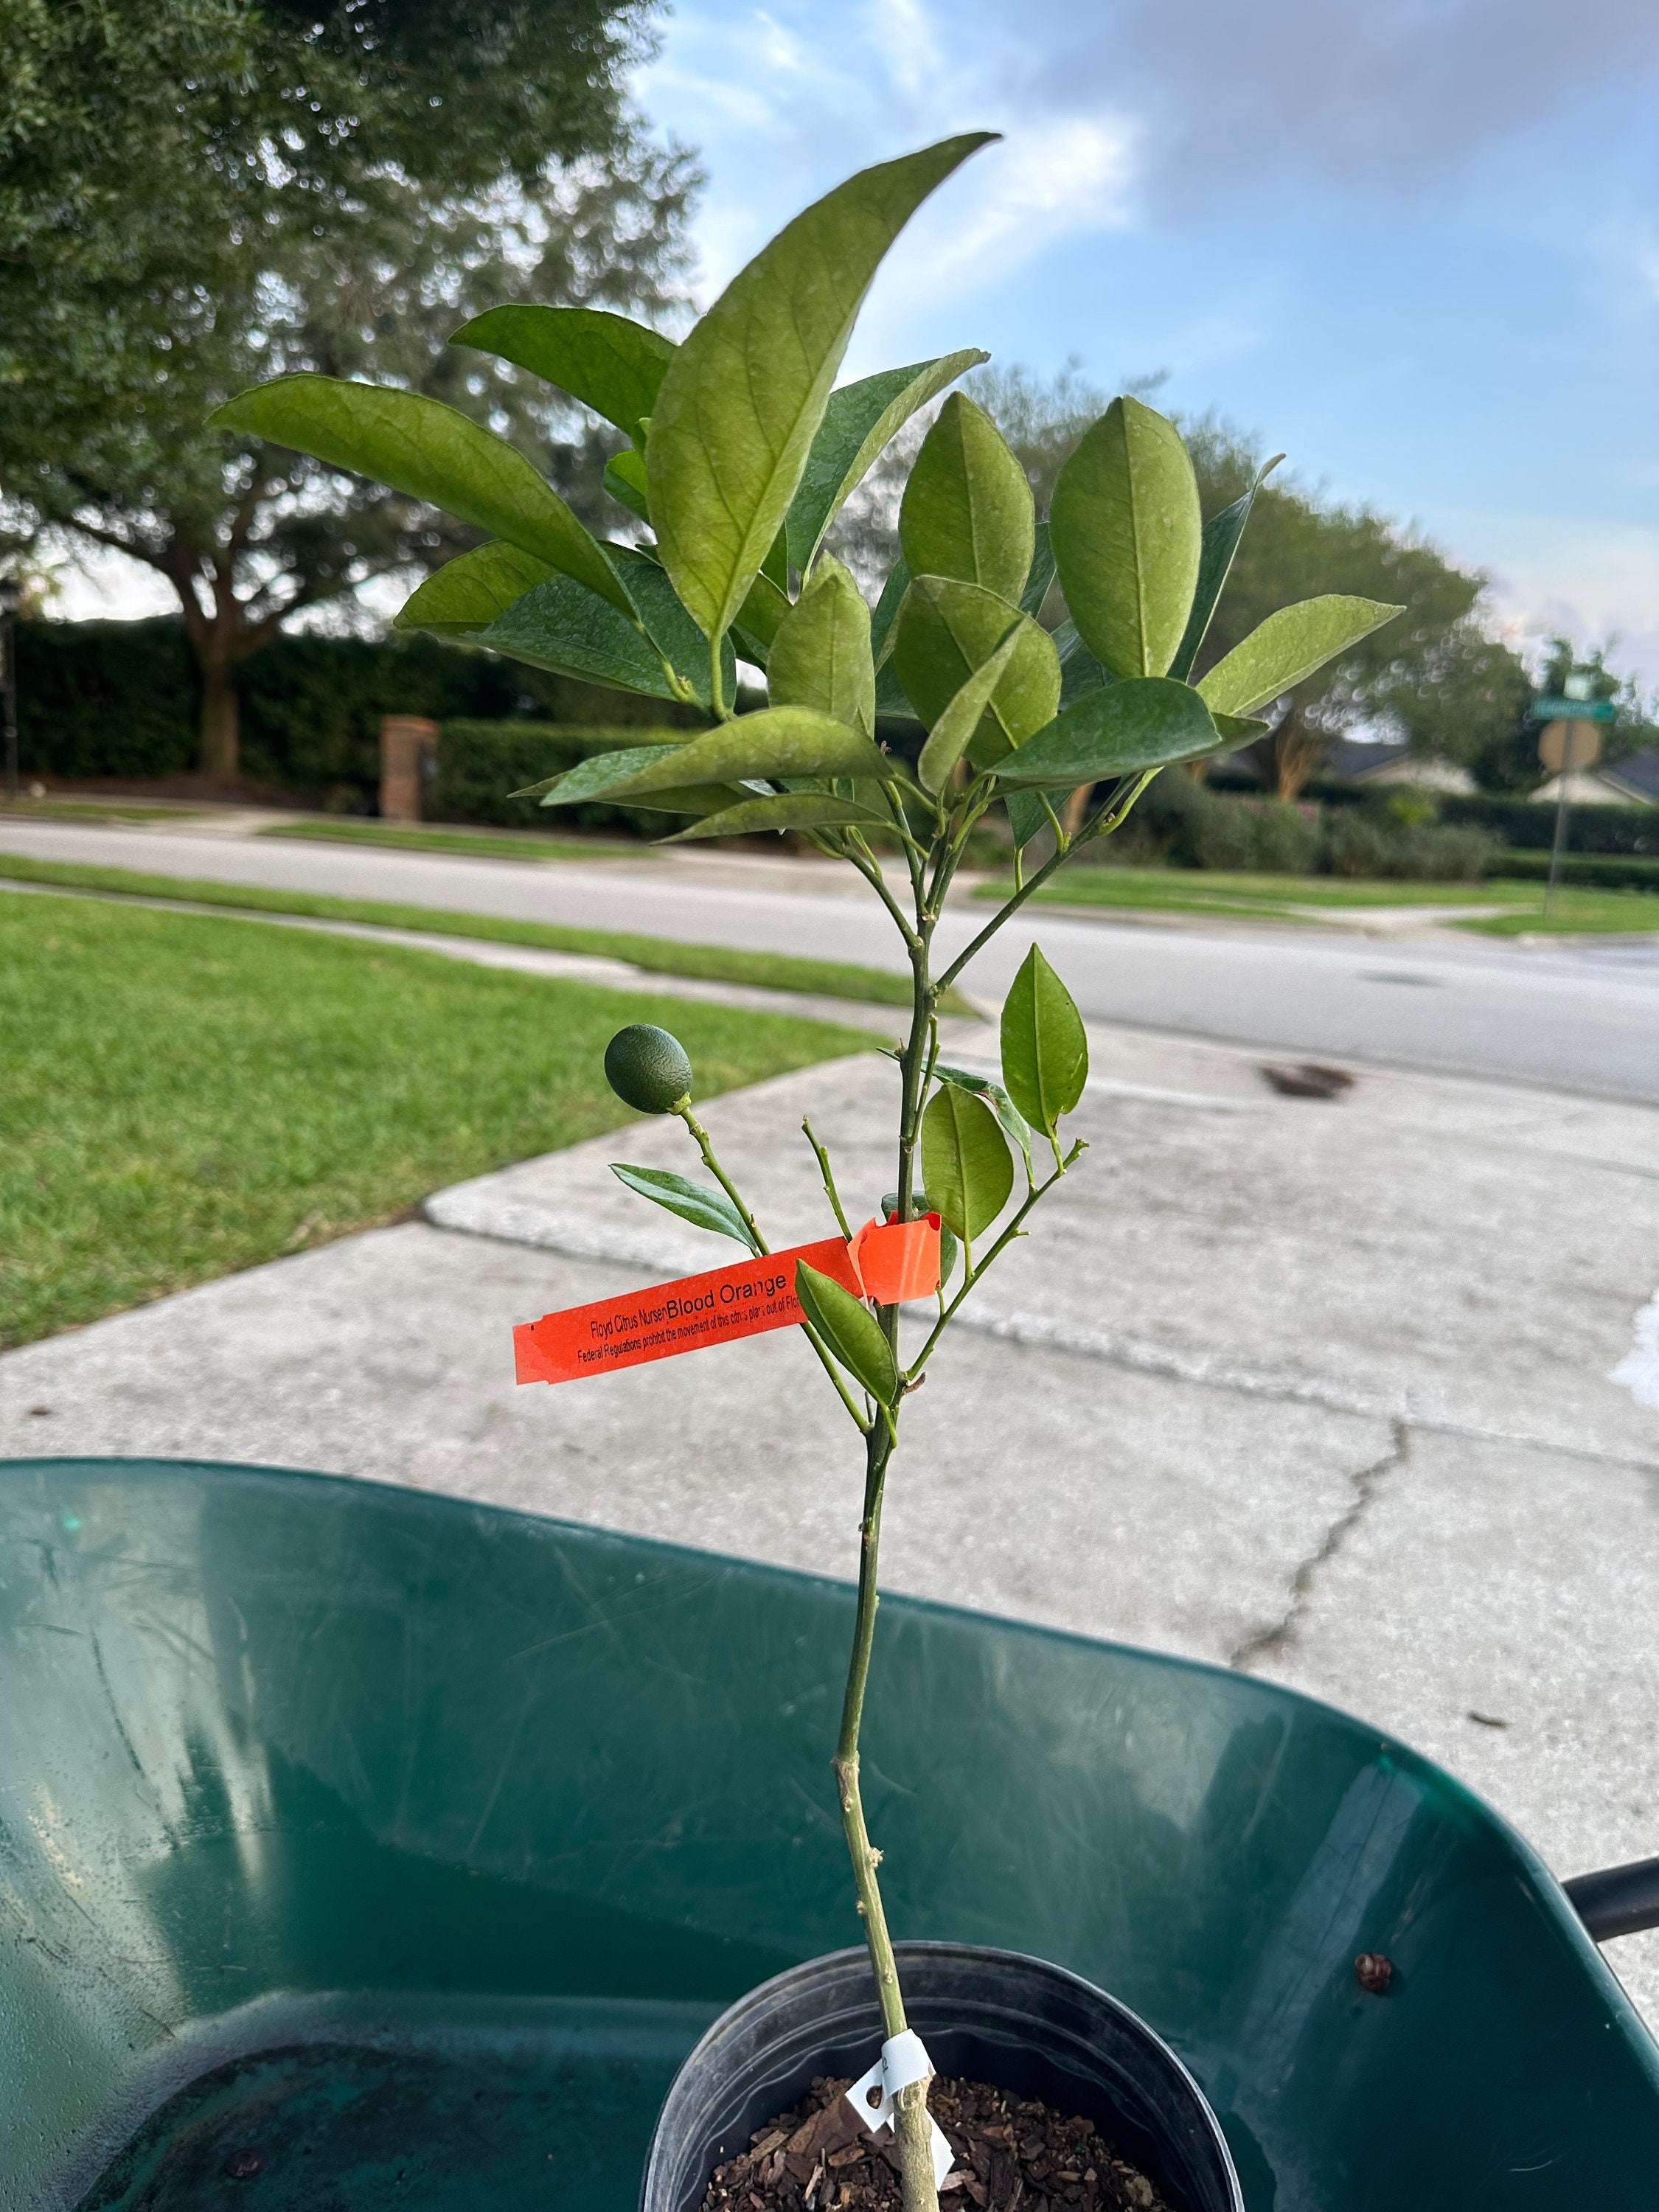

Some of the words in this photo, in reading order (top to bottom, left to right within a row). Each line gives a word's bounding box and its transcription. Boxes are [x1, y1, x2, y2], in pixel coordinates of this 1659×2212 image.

[667, 1290, 714, 1318] Blood
[720, 1275, 787, 1304] Orange
[577, 1346, 604, 1363] Federal
[604, 1338, 641, 1358] Regulations
[666, 1328, 677, 1341] the
[678, 1321, 710, 1338] movement
[711, 1315, 717, 1329] of
[717, 1314, 728, 1328] this
[766, 1303, 777, 1316] out
[779, 1296, 785, 1312] of
[590, 1318, 613, 1340] Floyd
[614, 1313, 639, 1333] Citrus
